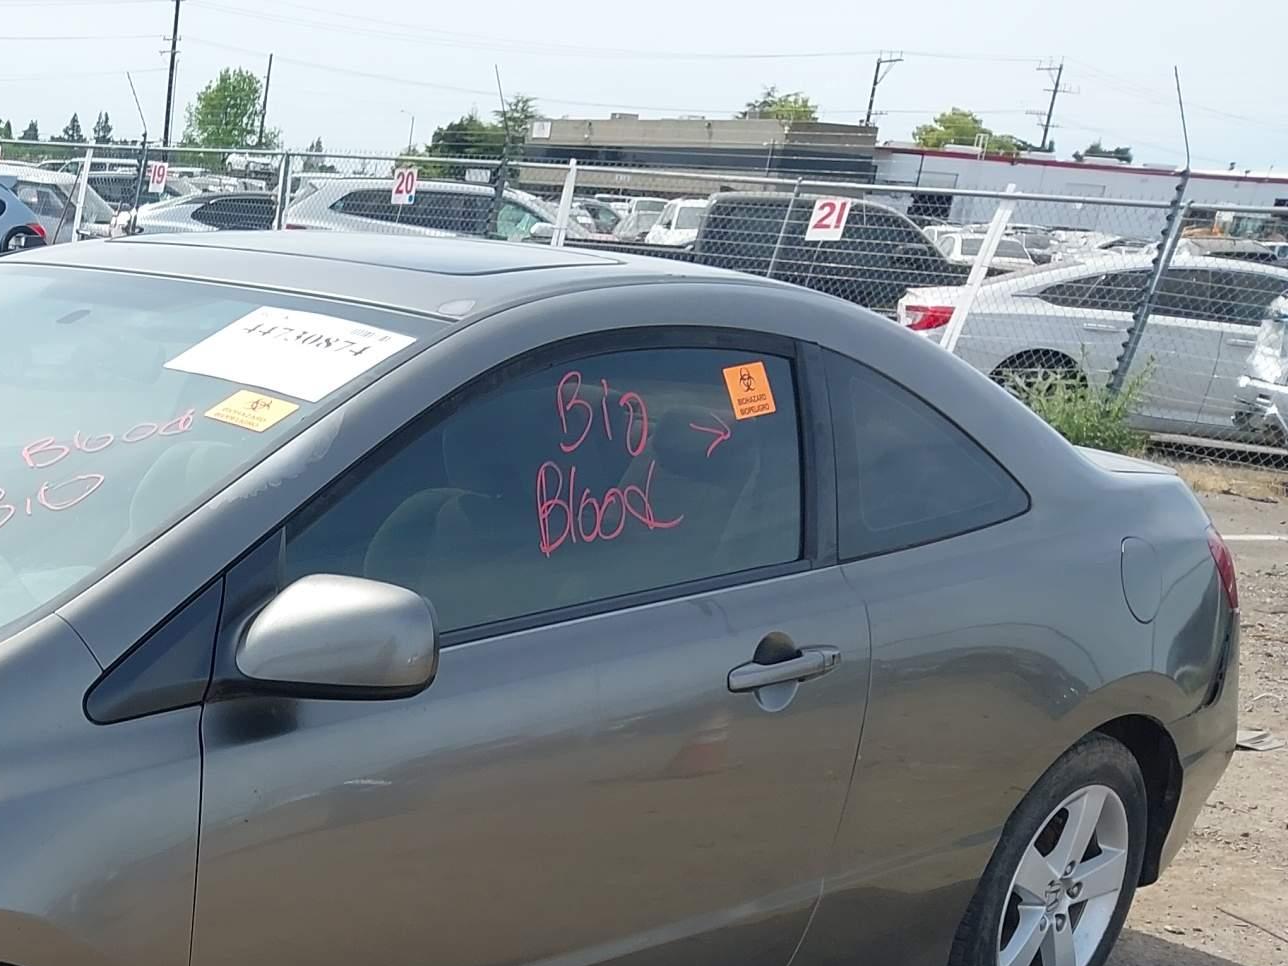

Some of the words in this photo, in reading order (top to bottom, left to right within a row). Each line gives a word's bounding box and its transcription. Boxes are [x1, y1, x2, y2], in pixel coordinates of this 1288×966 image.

[152, 164, 165, 184] 19
[395, 171, 414, 194] 20
[812, 201, 847, 229] 21
[243, 323, 372, 357] 44730874
